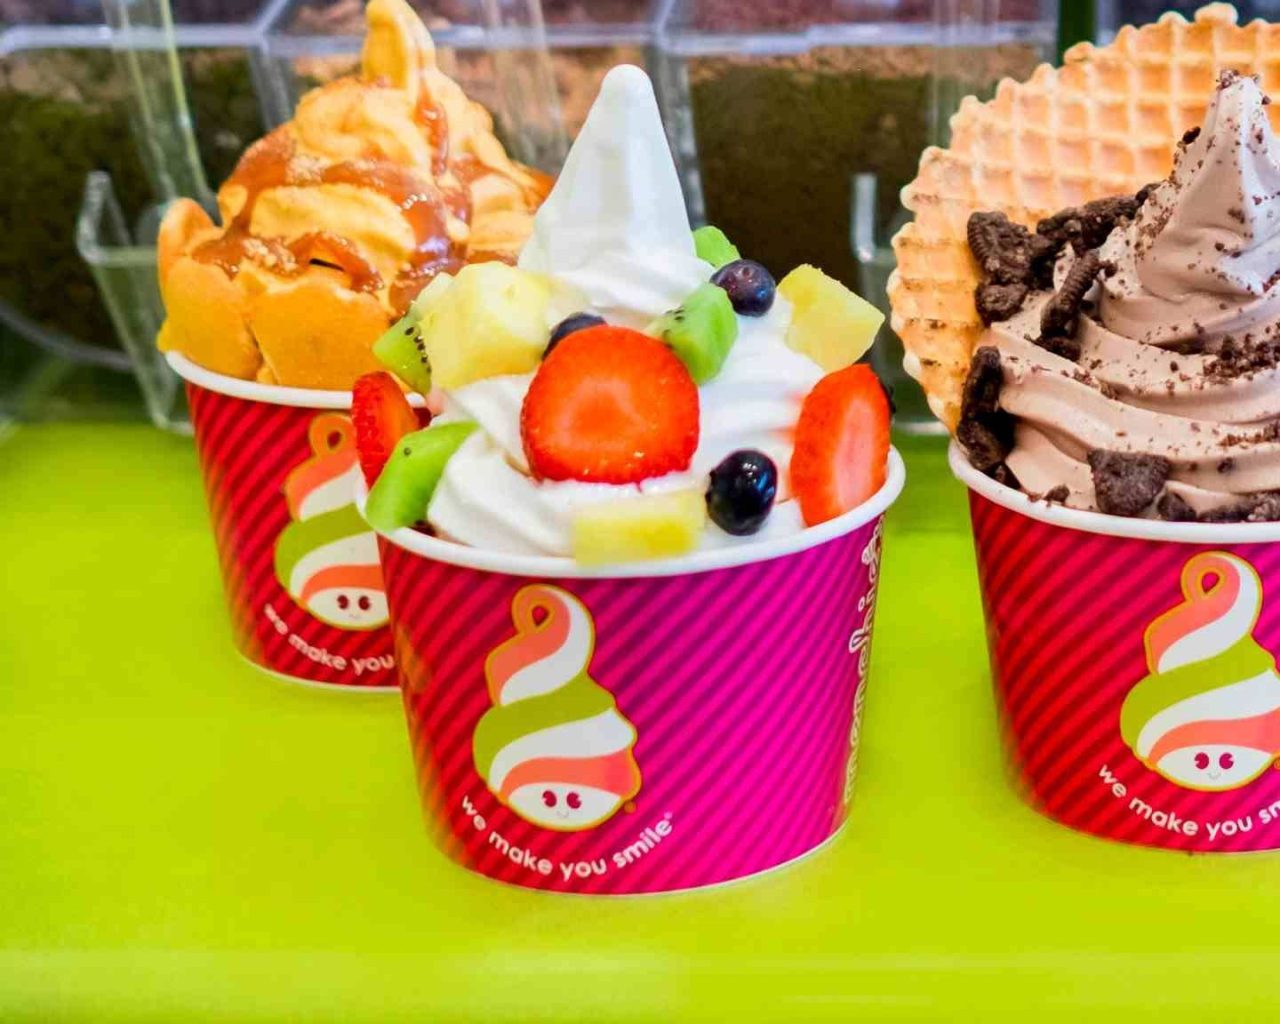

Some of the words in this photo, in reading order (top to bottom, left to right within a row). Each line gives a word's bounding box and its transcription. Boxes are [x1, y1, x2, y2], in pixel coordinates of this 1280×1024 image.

[263, 602, 289, 635] we
[287, 633, 347, 671] make
[351, 654, 395, 677] you
[461, 794, 487, 832] we
[488, 831, 554, 876] make
[559, 857, 608, 882] you
[1098, 763, 1127, 799] we
[1127, 796, 1200, 837] make
[1205, 814, 1254, 842] you
